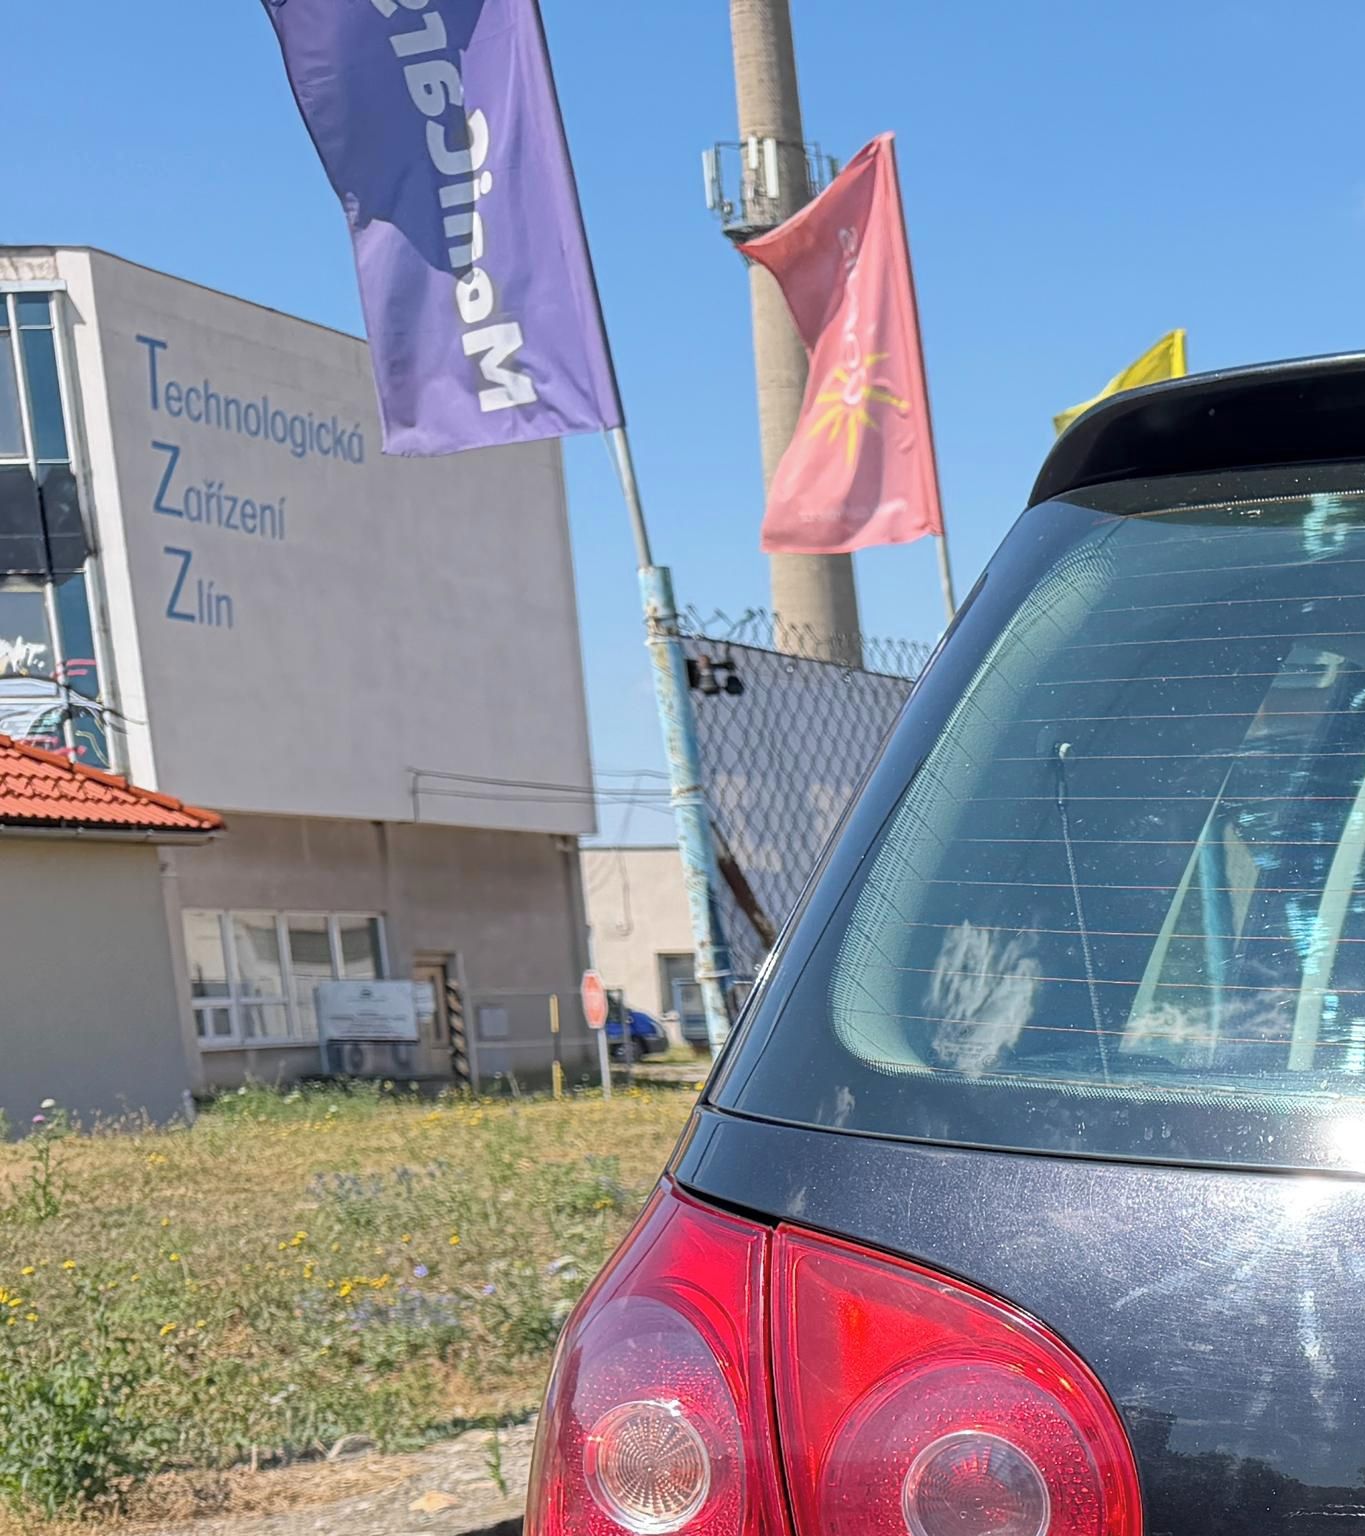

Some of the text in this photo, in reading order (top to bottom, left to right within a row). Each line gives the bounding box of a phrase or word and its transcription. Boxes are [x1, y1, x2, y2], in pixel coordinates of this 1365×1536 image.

[135, 335, 365, 465] Technologická
[152, 441, 287, 541] Zařízení
[163, 547, 235, 630] Zlín
